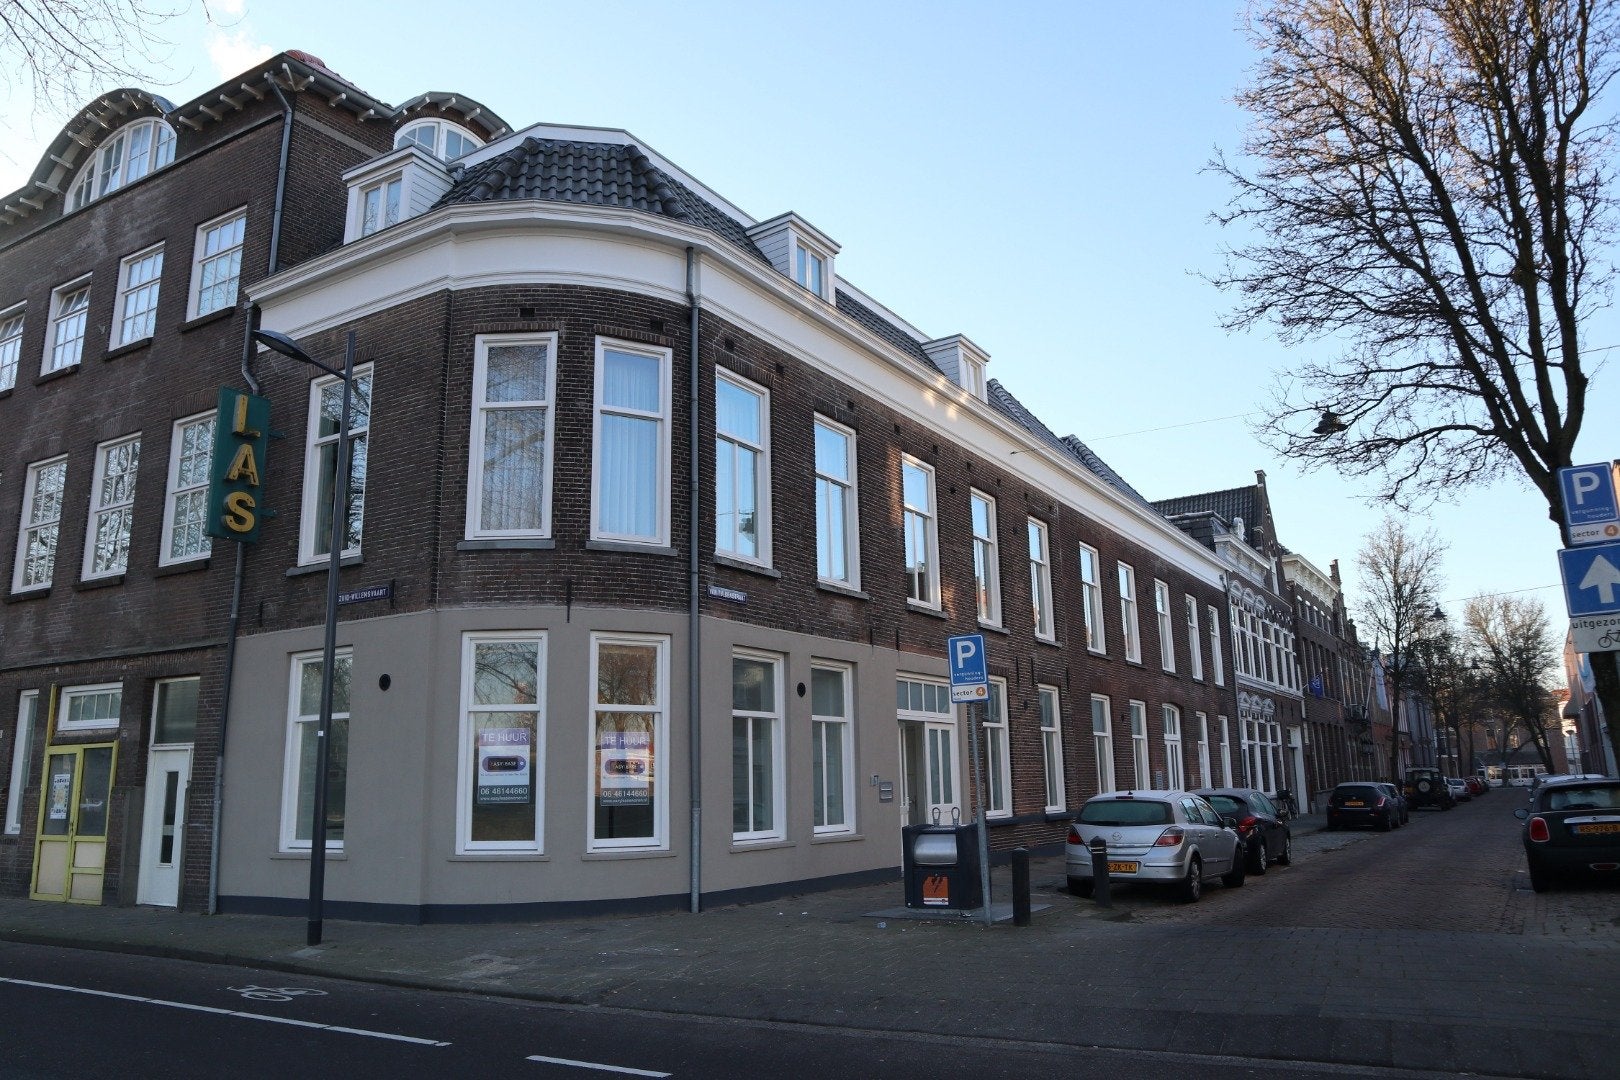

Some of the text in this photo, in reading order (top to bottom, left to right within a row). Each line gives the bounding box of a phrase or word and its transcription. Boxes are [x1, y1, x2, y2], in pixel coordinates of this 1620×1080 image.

[224, 394, 261, 532] LAS
[1571, 471, 1600, 505] P
[1572, 526, 1616, 538] sector 4
[956, 640, 976, 669] P
[482, 732, 527, 742] TE HUUR
[605, 736, 647, 745] TE HUUR
